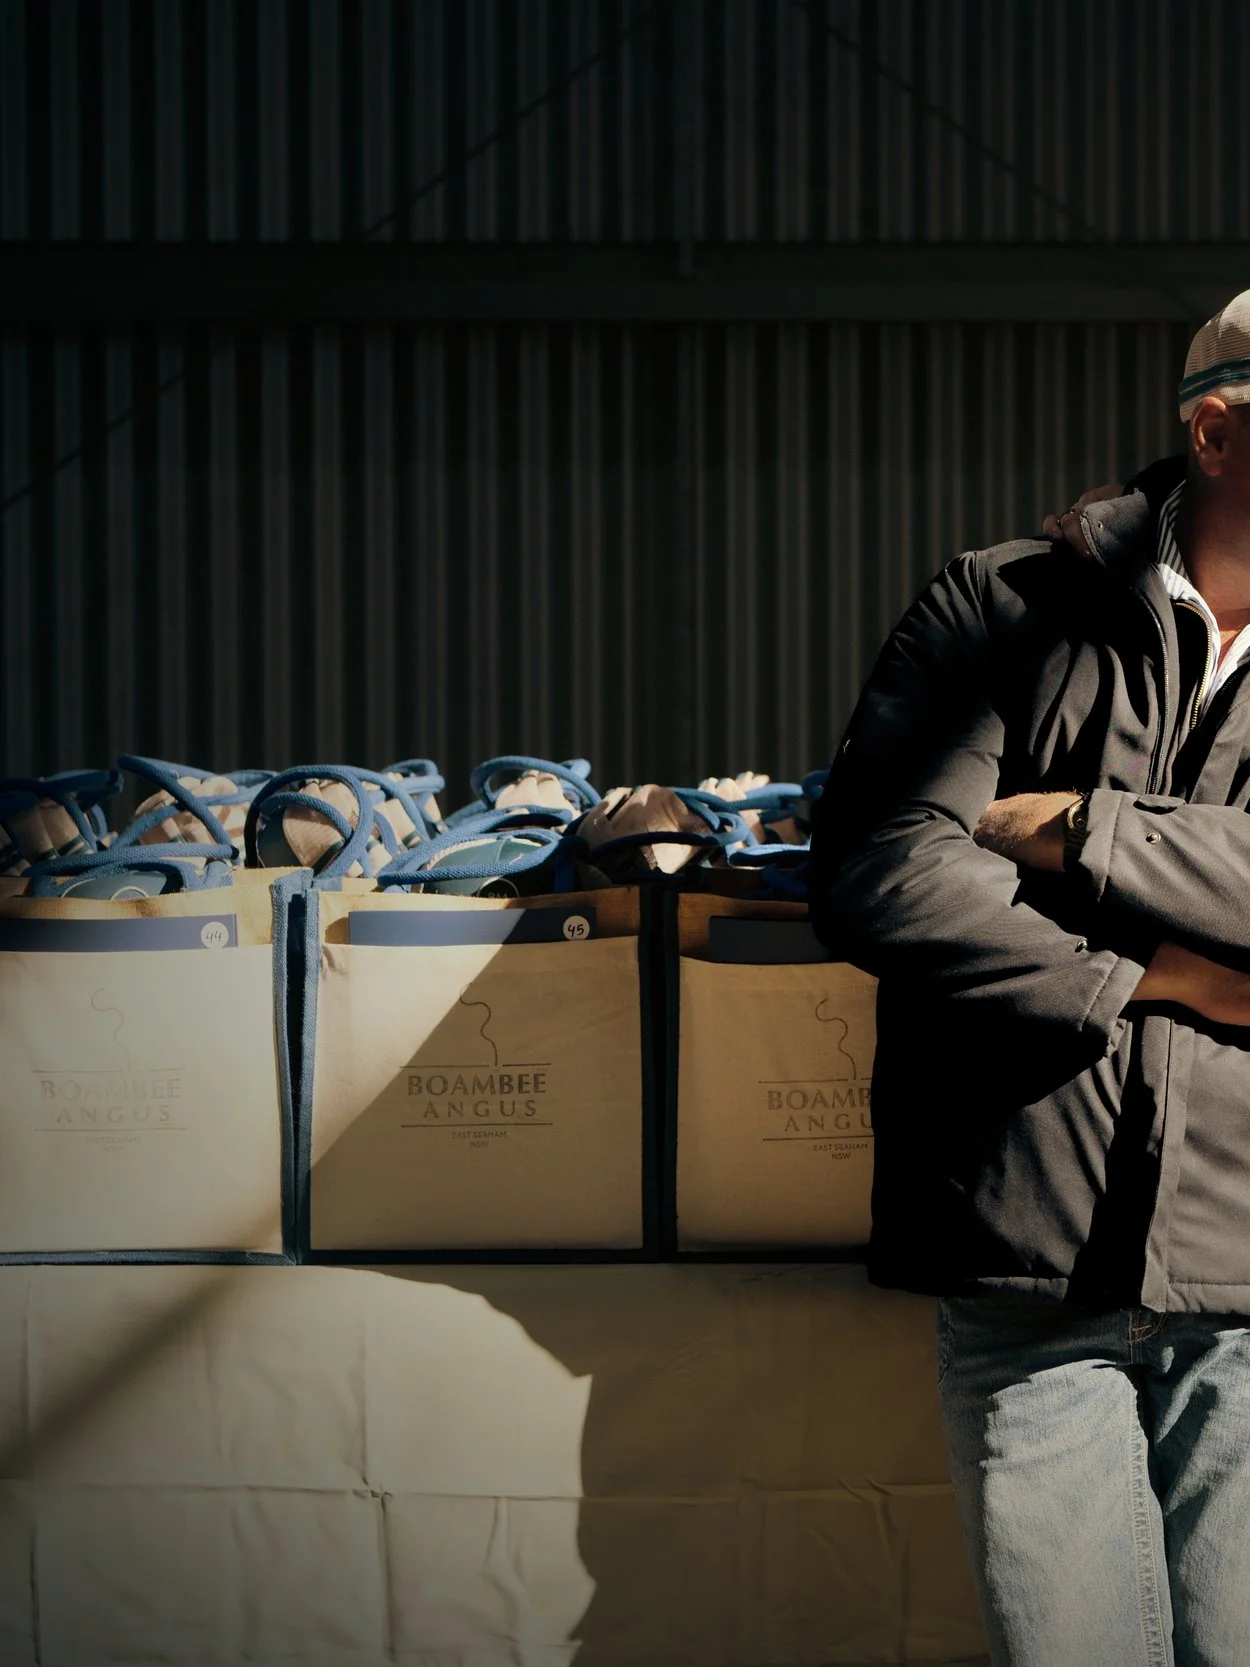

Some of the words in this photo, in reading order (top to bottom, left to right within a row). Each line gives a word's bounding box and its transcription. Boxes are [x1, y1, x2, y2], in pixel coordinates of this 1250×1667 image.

[205, 929, 222, 944] 44
[567, 923, 585, 937] 45
[38, 1077, 183, 1101] BOAMBEE
[407, 1072, 547, 1097] BOAMBEE
[55, 1103, 173, 1125] ANGUS
[423, 1099, 537, 1119] ANGUS
[813, 1144, 832, 1153] EAST
[834, 1143, 869, 1152] SEAHAM
[832, 1153, 851, 1161] NSW
